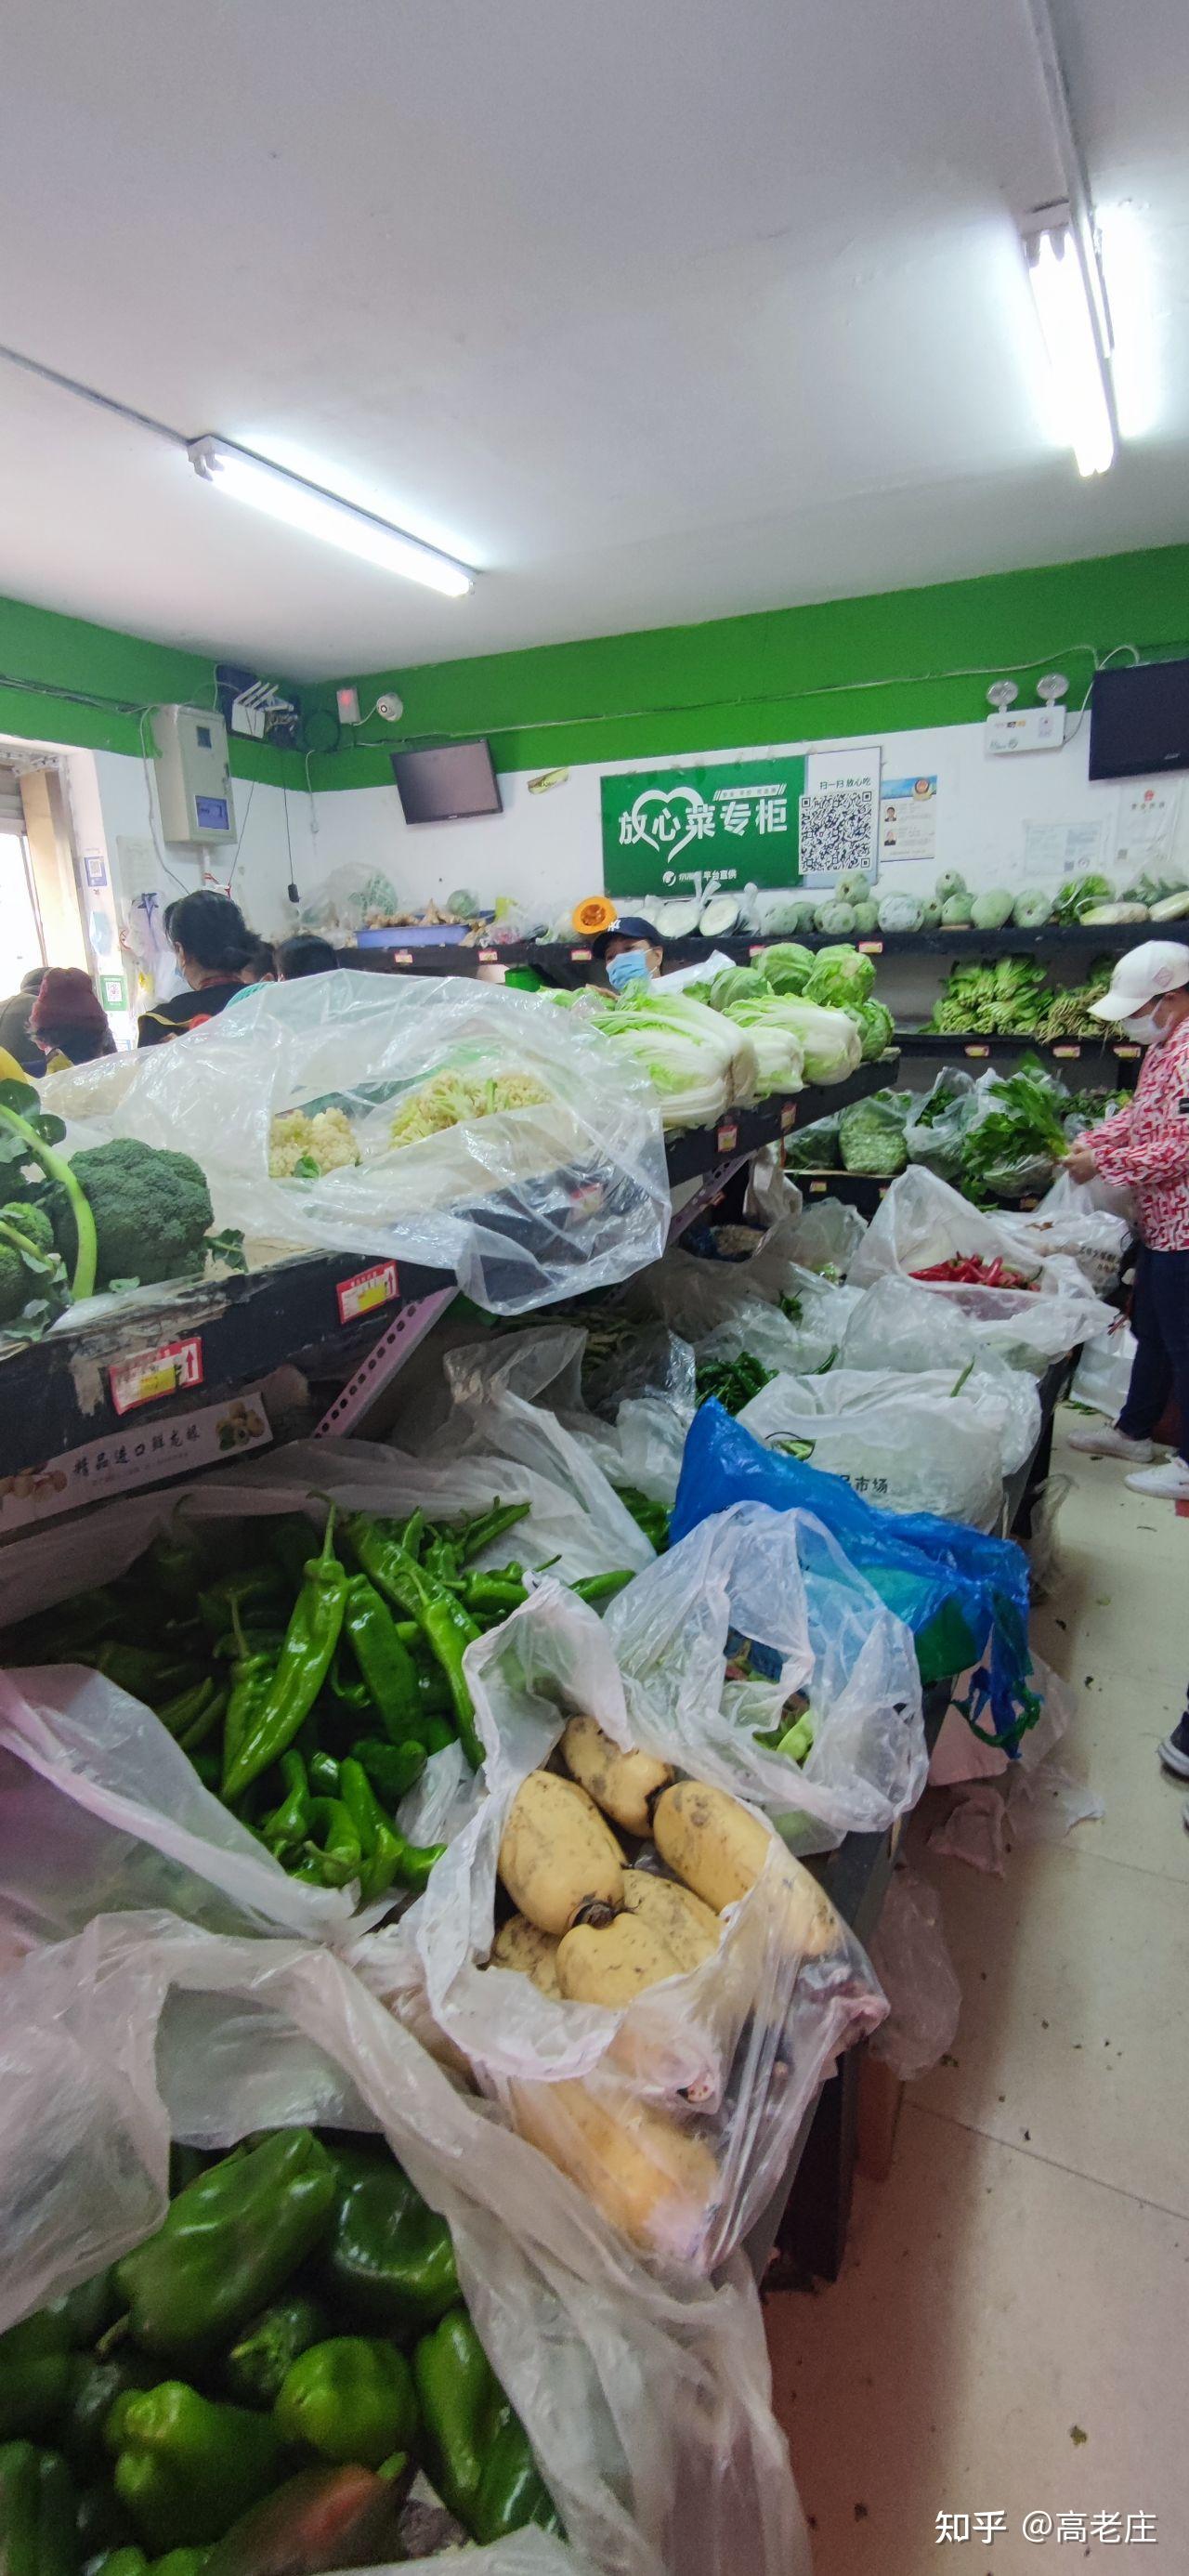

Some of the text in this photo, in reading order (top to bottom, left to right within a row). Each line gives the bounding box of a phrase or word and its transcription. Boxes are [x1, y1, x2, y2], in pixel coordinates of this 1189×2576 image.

[819, 778, 843, 790] 扫一扫
[618, 798, 788, 845] 放心菜专柜
